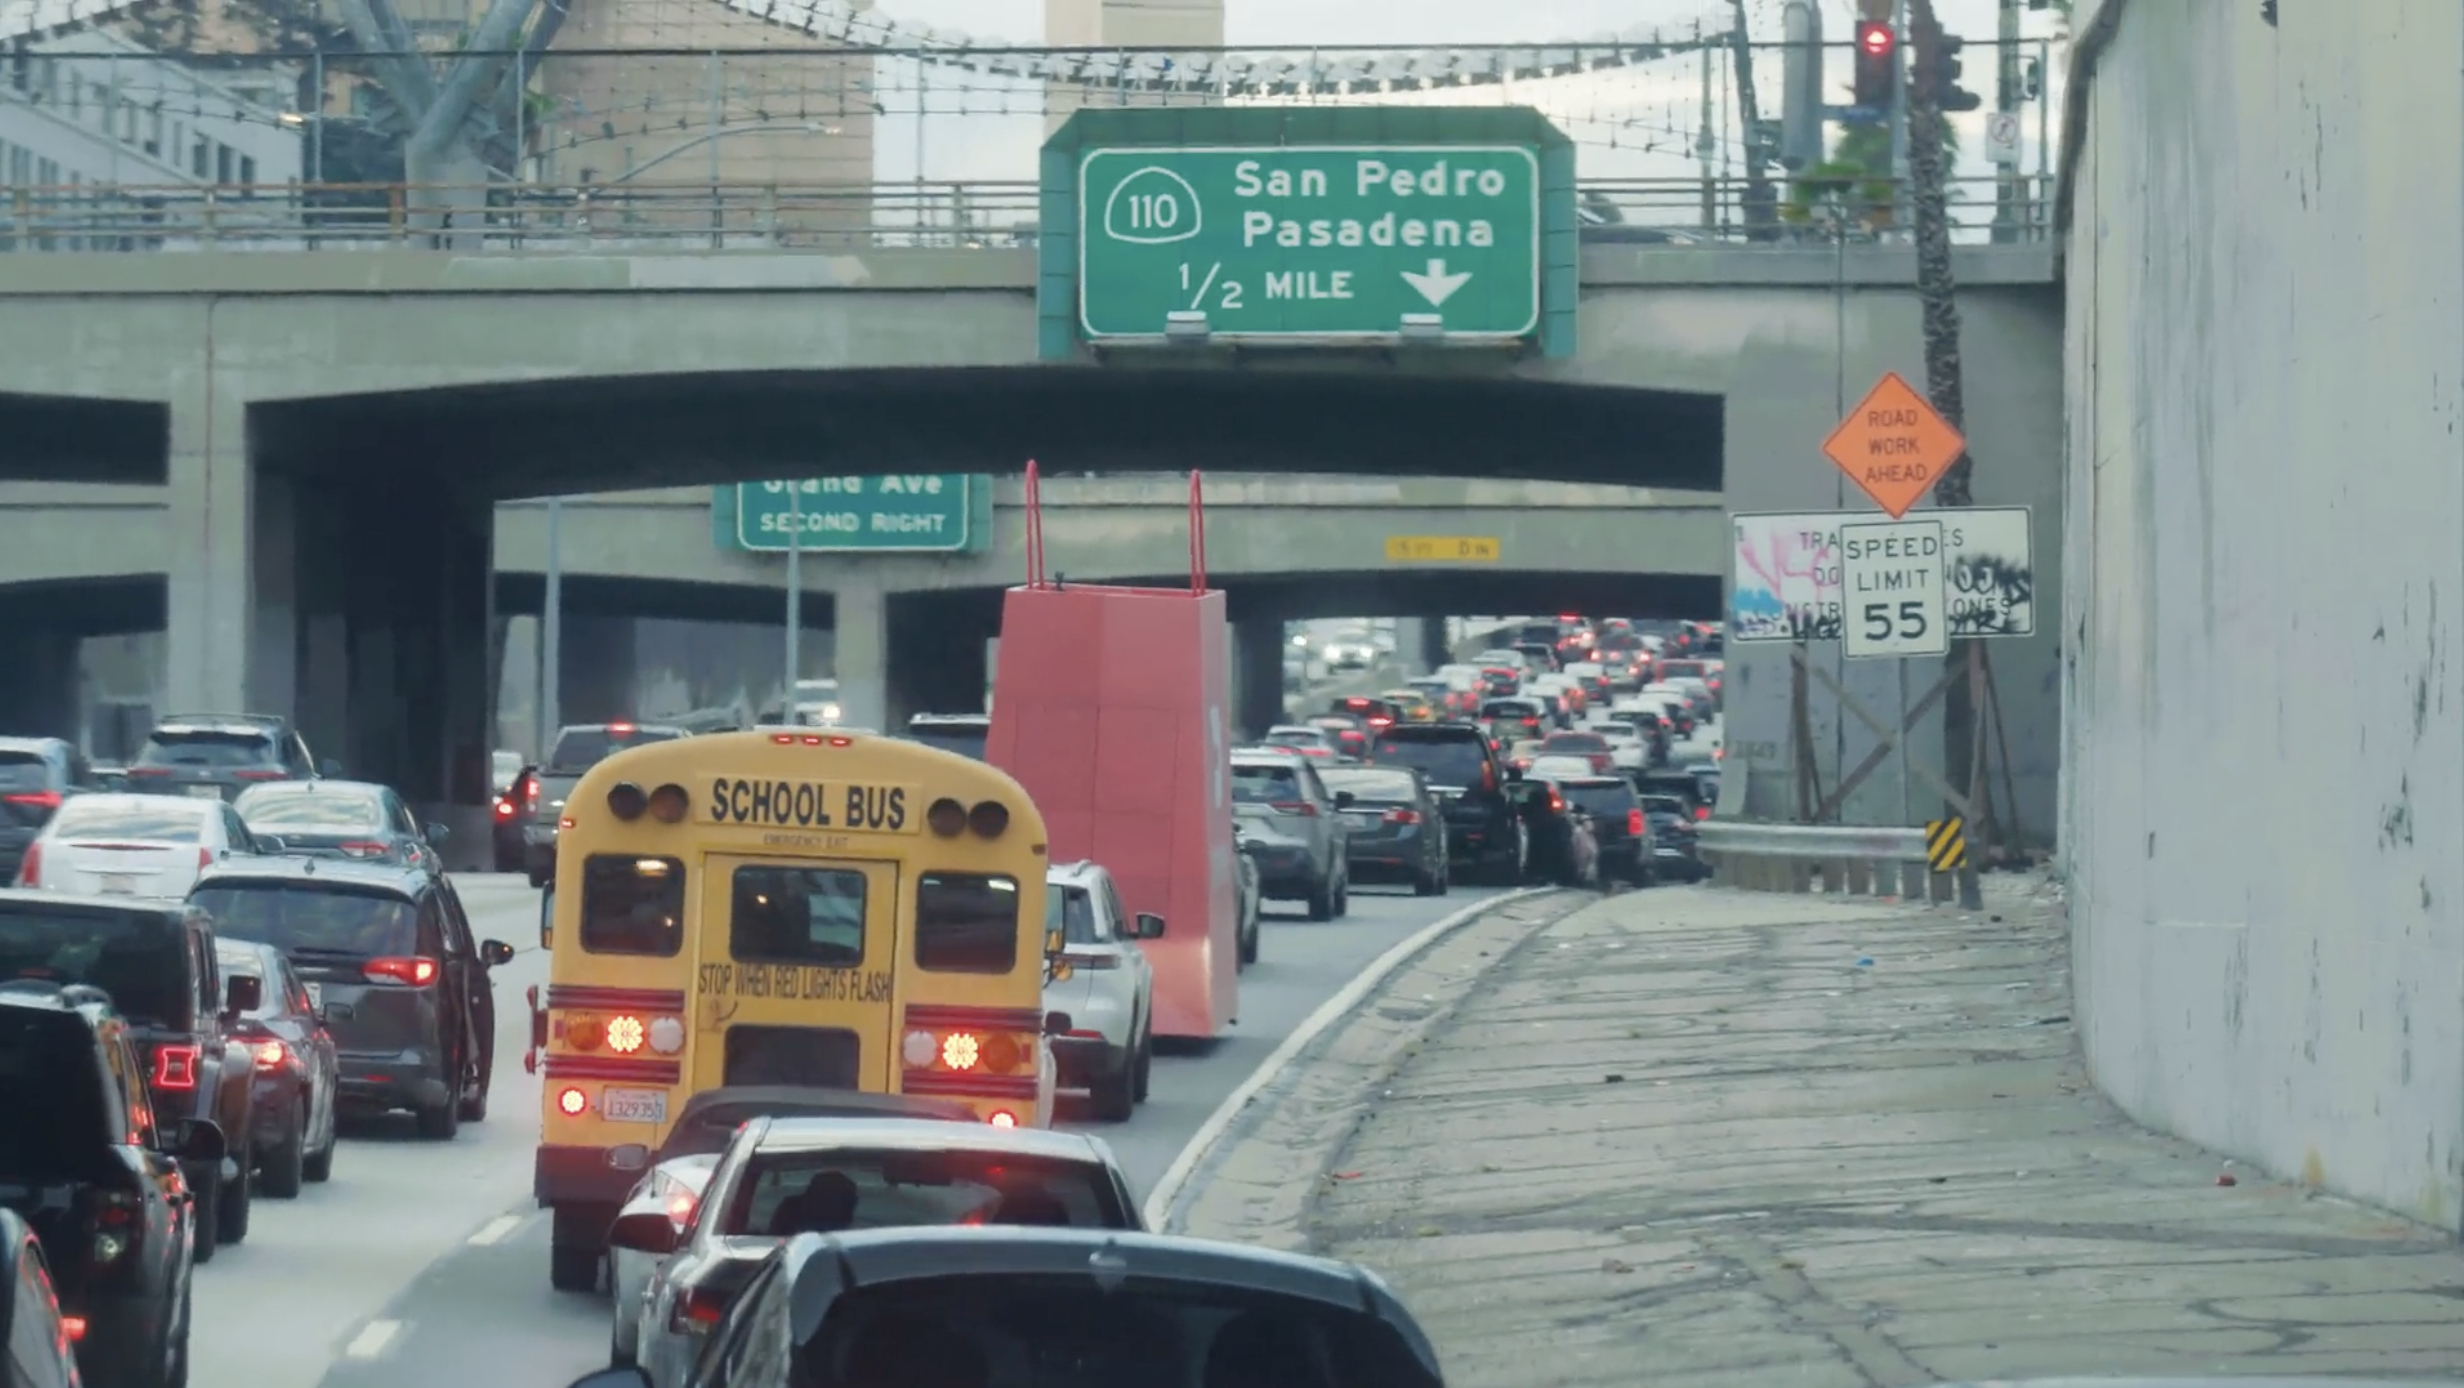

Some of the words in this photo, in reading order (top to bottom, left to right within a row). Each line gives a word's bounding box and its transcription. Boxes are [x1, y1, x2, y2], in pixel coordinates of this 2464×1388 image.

[1234, 160, 1327, 197] San
[1356, 160, 1506, 197] Pedro
[1129, 193, 1179, 229] 110
[1243, 210, 1495, 248] Pasadena
[1178, 261, 1243, 310] 1/2
[1264, 271, 1354, 300] MILE
[1867, 409, 1918, 427] ROAD
[1868, 437, 1920, 456] WORK
[879, 474, 943, 494] Ave
[1865, 463, 1928, 483] AHEAD
[760, 511, 860, 532] SECOND
[870, 512, 947, 533] RIGHT
[1846, 536, 1938, 560] SPEED
[1857, 568, 1929, 592] LIMIT
[1864, 600, 1928, 641] 55
[710, 777, 831, 826] SCHOOL
[846, 785, 906, 831] BUS
[699, 963, 732, 996] STOP
[734, 964, 771, 998] WHEN
[774, 965, 799, 999] RED
[802, 966, 847, 1001] LIGHTS
[850, 970, 893, 1004] FLASH
